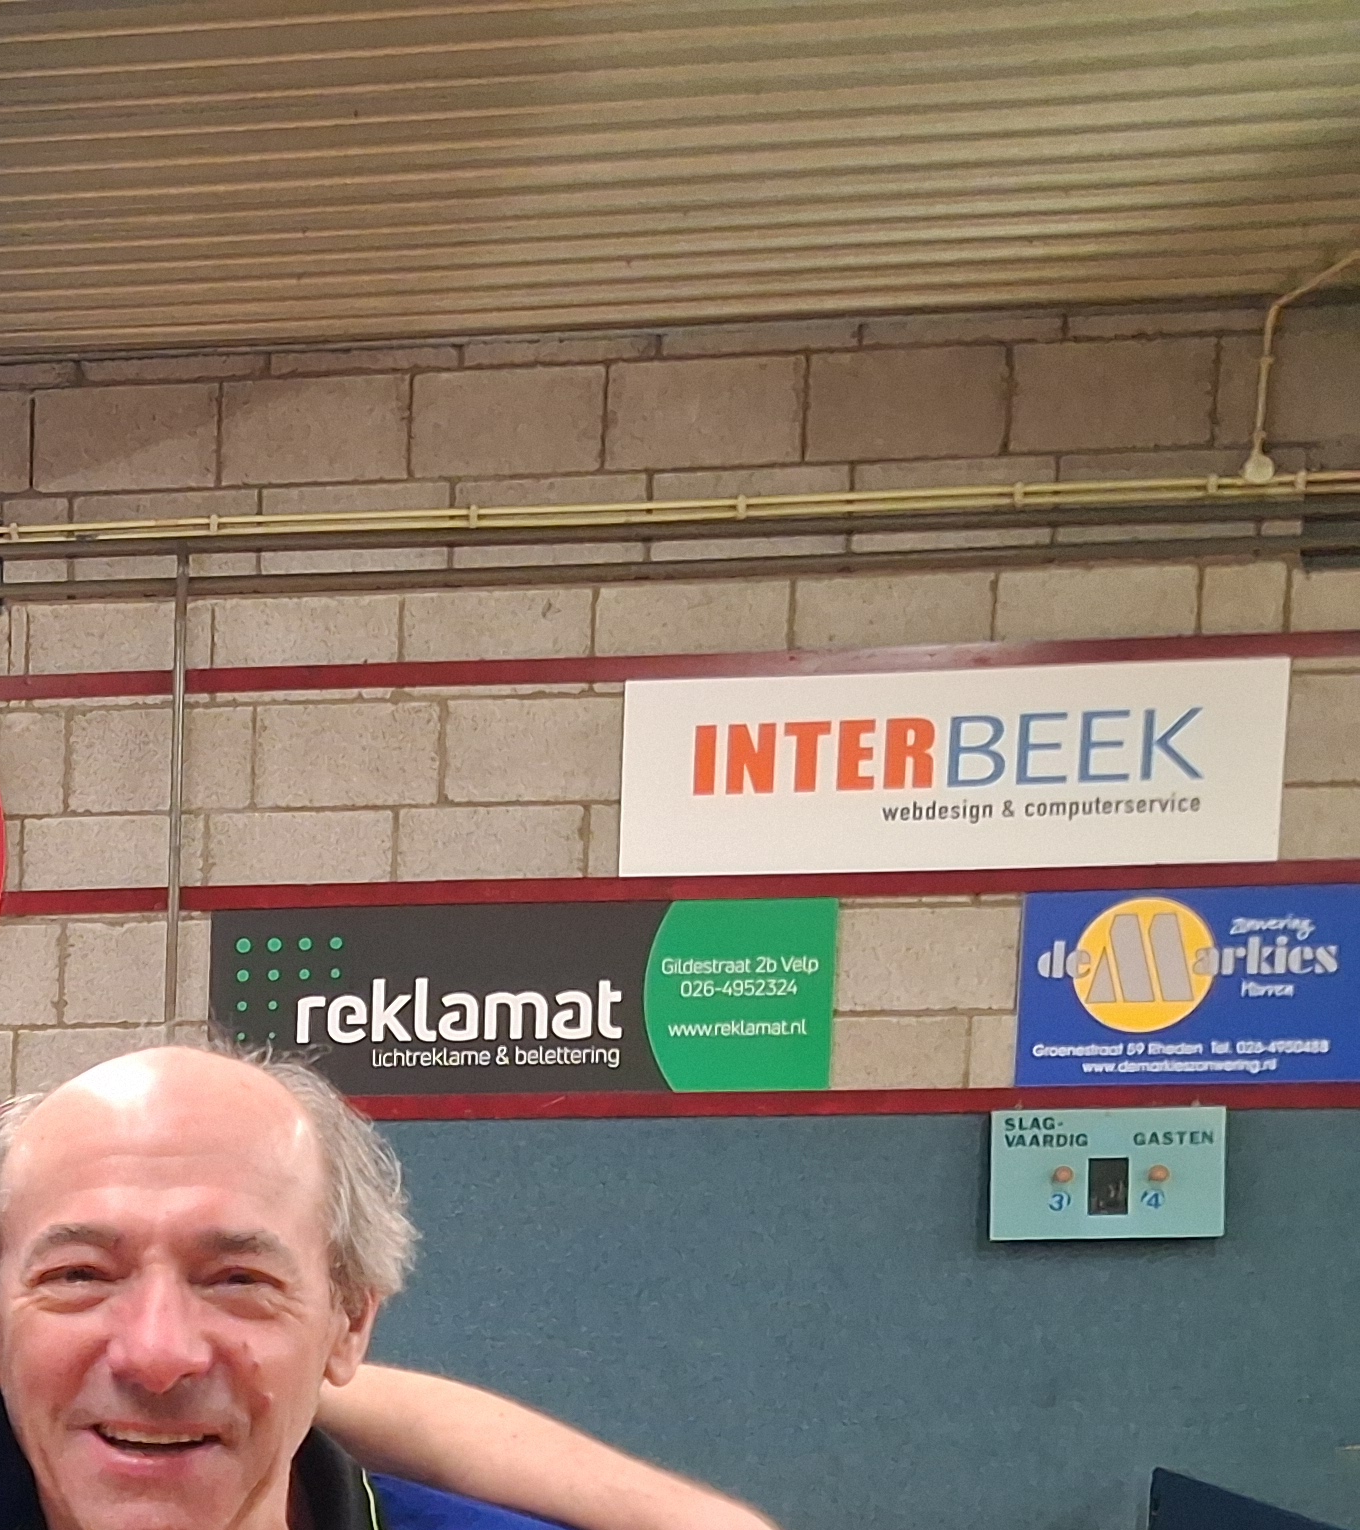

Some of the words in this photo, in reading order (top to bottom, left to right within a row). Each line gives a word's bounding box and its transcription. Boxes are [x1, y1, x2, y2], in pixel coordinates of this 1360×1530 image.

[692, 706, 1204, 796] INTERBEEK
[882, 800, 993, 824] webdesign
[1002, 800, 1015, 818] &
[1024, 792, 1201, 821] computerservice
[661, 957, 751, 975] Gildestraat
[755, 956, 777, 973] 2b
[781, 955, 819, 974] Velp
[680, 979, 798, 997] 026-4952324
[295, 978, 623, 1044] reklamat
[667, 1018, 808, 1037] www.reklamat.nl
[371, 1048, 491, 1068] lichtreklame
[496, 1045, 509, 1065] &
[515, 1045, 621, 1069] belettering
[1005, 1117, 1064, 1131] SLAG-
[1005, 1133, 1089, 1148] VAARDIG
[1133, 1130, 1214, 1146] GASTEN
